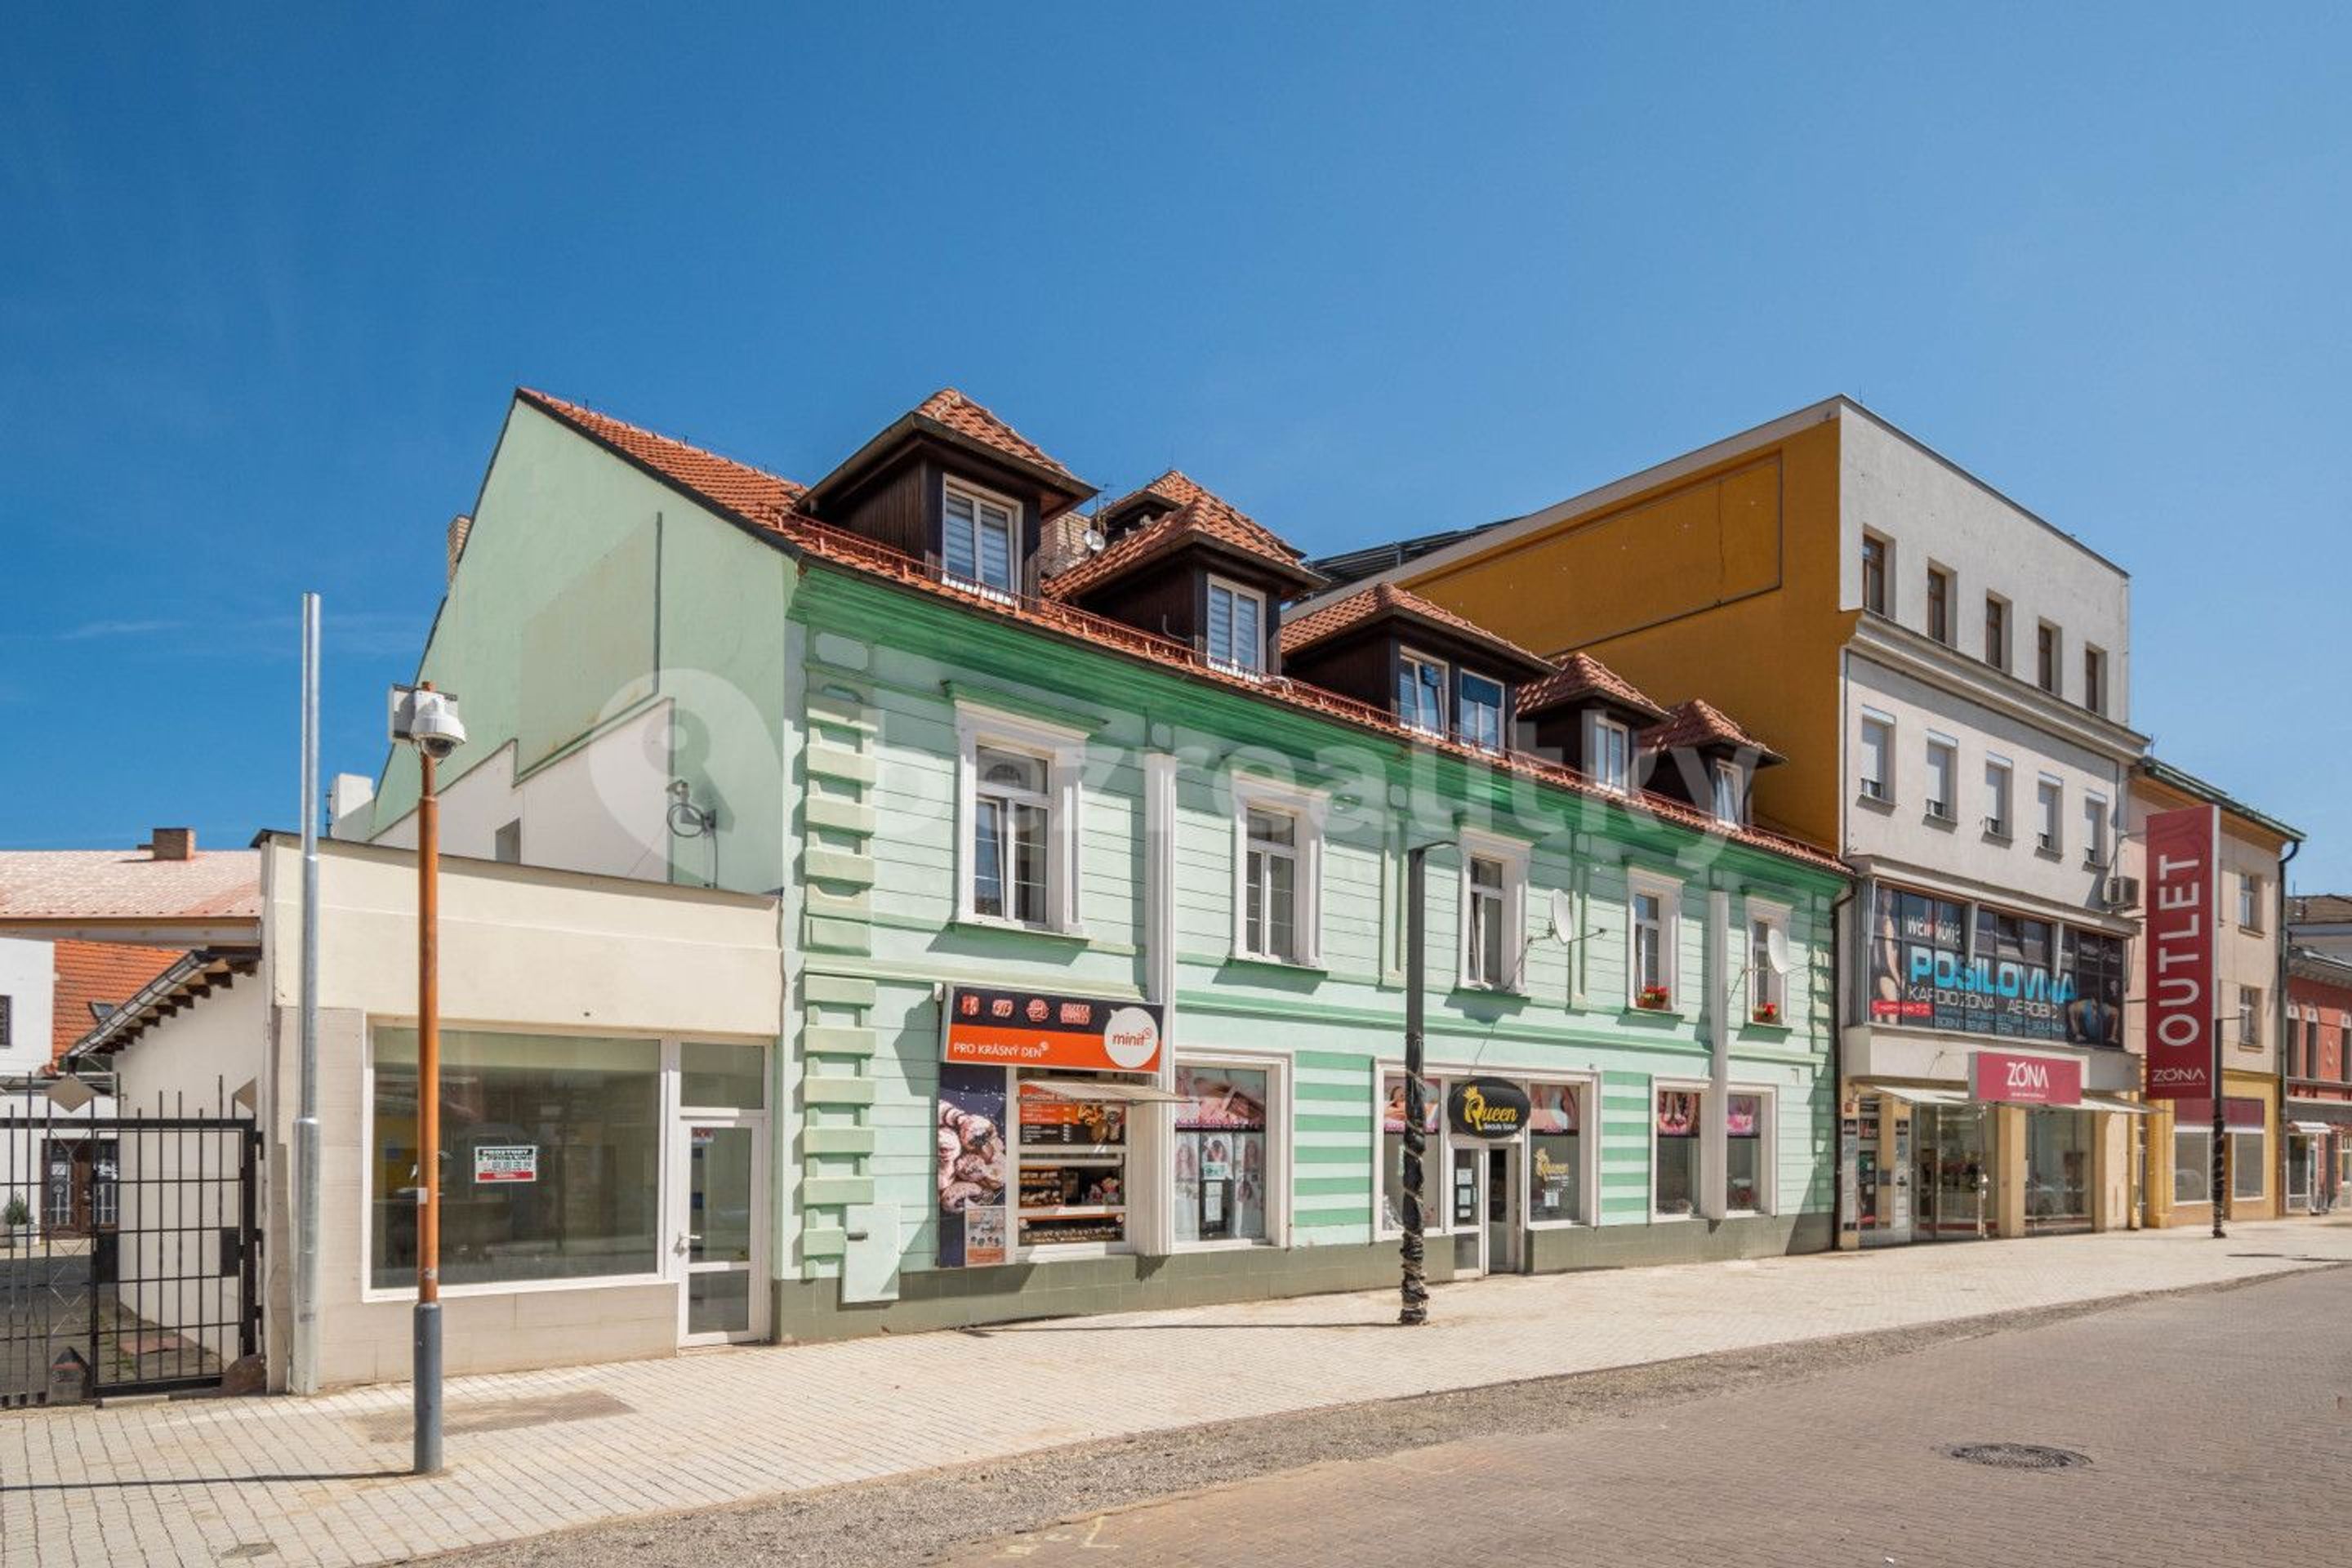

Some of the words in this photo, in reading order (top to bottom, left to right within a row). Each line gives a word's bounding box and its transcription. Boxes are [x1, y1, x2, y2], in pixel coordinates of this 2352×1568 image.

[2158, 854, 2200, 1047] OUTLET
[1910, 946, 2078, 1004] POSILOVNA
[953, 1042, 975, 1055] PRO
[1021, 1047, 1042, 1058] DEN
[1111, 1031, 1146, 1047] minit
[1463, 1091, 1518, 1131] Queen
